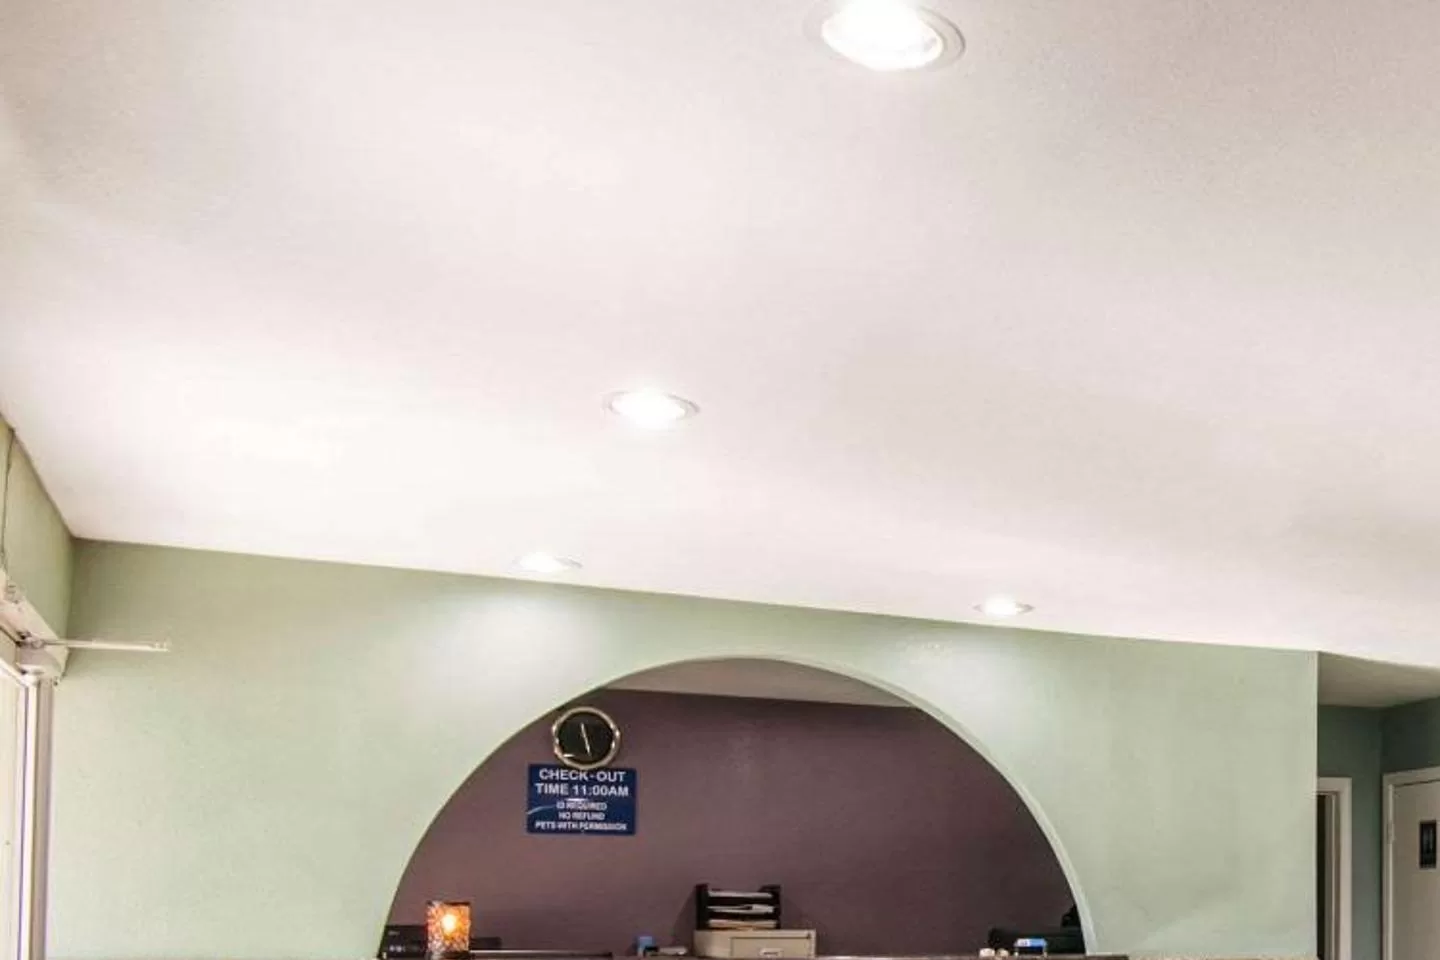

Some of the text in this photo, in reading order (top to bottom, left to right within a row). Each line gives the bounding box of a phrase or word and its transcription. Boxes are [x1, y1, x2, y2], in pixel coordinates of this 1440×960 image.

[535, 783, 629, 797] TIME 11:00AM
[558, 811, 605, 821] NO REFUND
[535, 820, 555, 830] PETS
